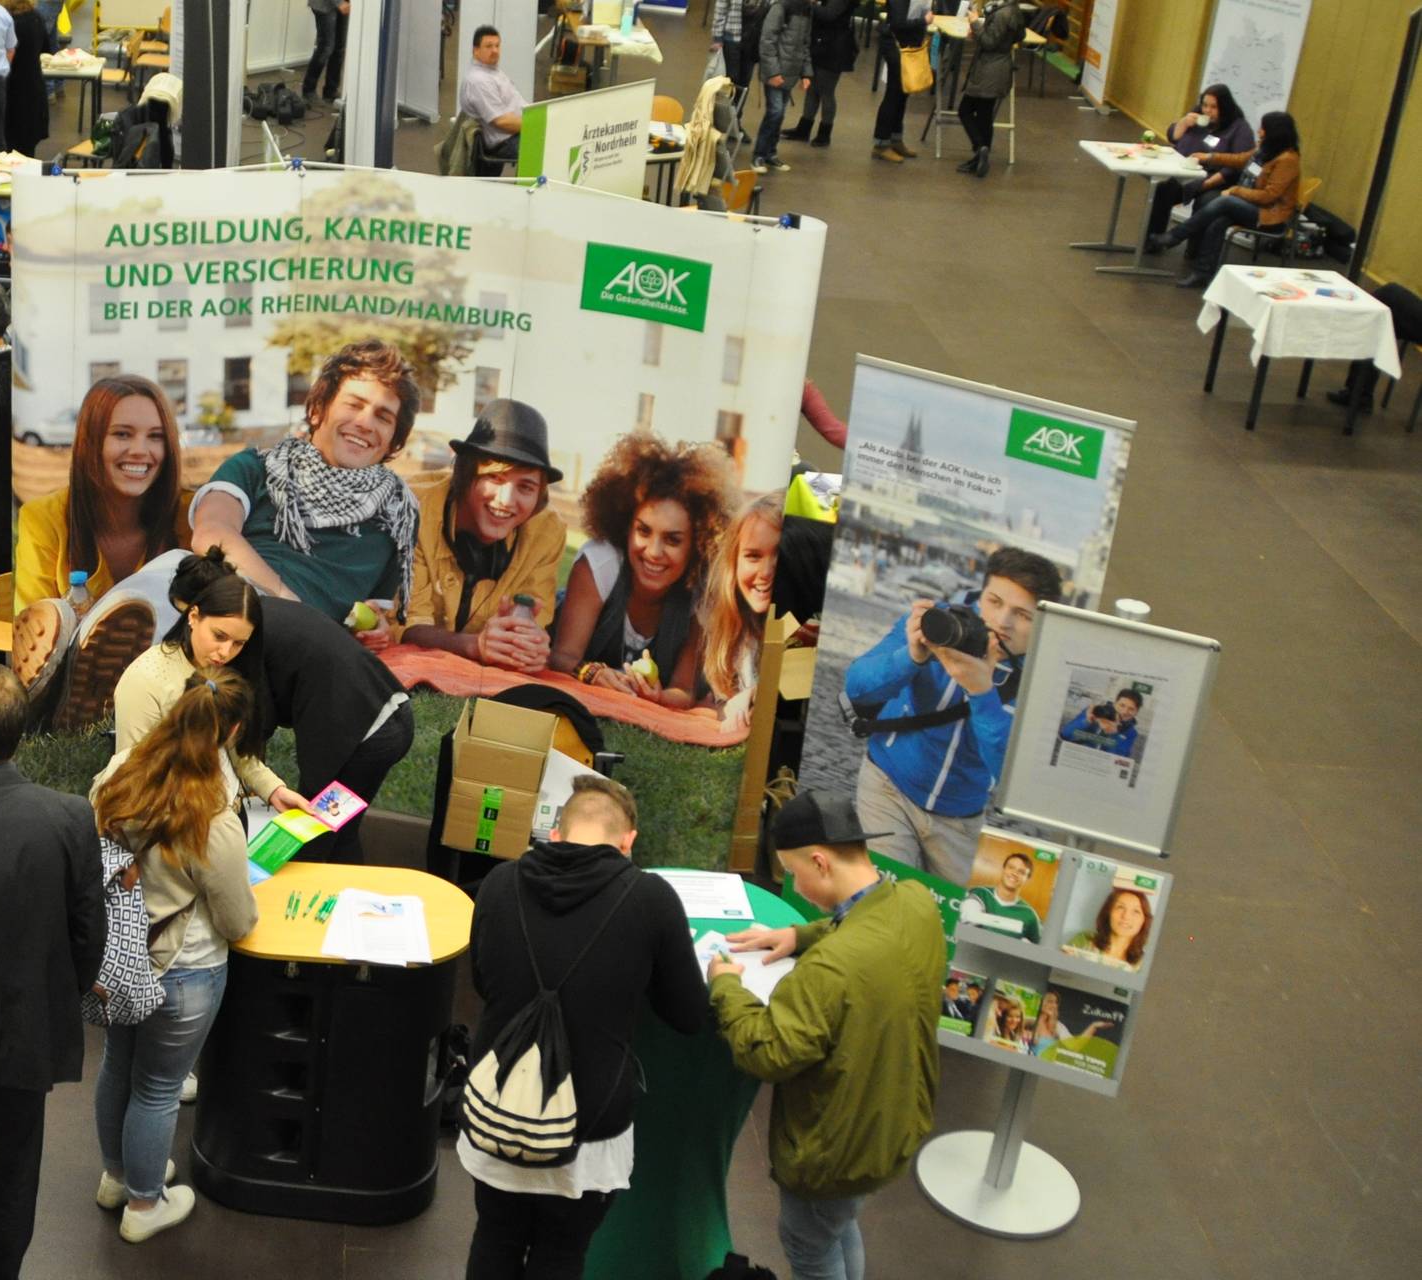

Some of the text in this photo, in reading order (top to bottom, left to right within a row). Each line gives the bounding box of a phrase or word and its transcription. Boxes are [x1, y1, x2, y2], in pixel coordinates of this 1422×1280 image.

[583, 119, 638, 141] Ärztekammer
[595, 134, 637, 153] Nordrhein
[105, 216, 472, 250] AUSBILDUNG, KARRIERE
[105, 256, 415, 288] UND VERSICHERUNG
[605, 261, 691, 305] AOK
[600, 290, 615, 301] Die
[104, 293, 533, 332] BEI DER AOK RHEINLAND/HAMBURG
[1024, 426, 1085, 459] AOK
[858, 453, 885, 465] immer
[886, 459, 904, 471] den
[906, 462, 952, 484] Menschen
[953, 477, 965, 487] im
[879, 446, 905, 459] Azubi
[922, 457, 938, 468] der
[940, 461, 961, 474] AOK
[963, 467, 986, 480] habe
[987, 474, 1002, 486] ich
[1082, 1003, 1125, 1022] Zukunft
